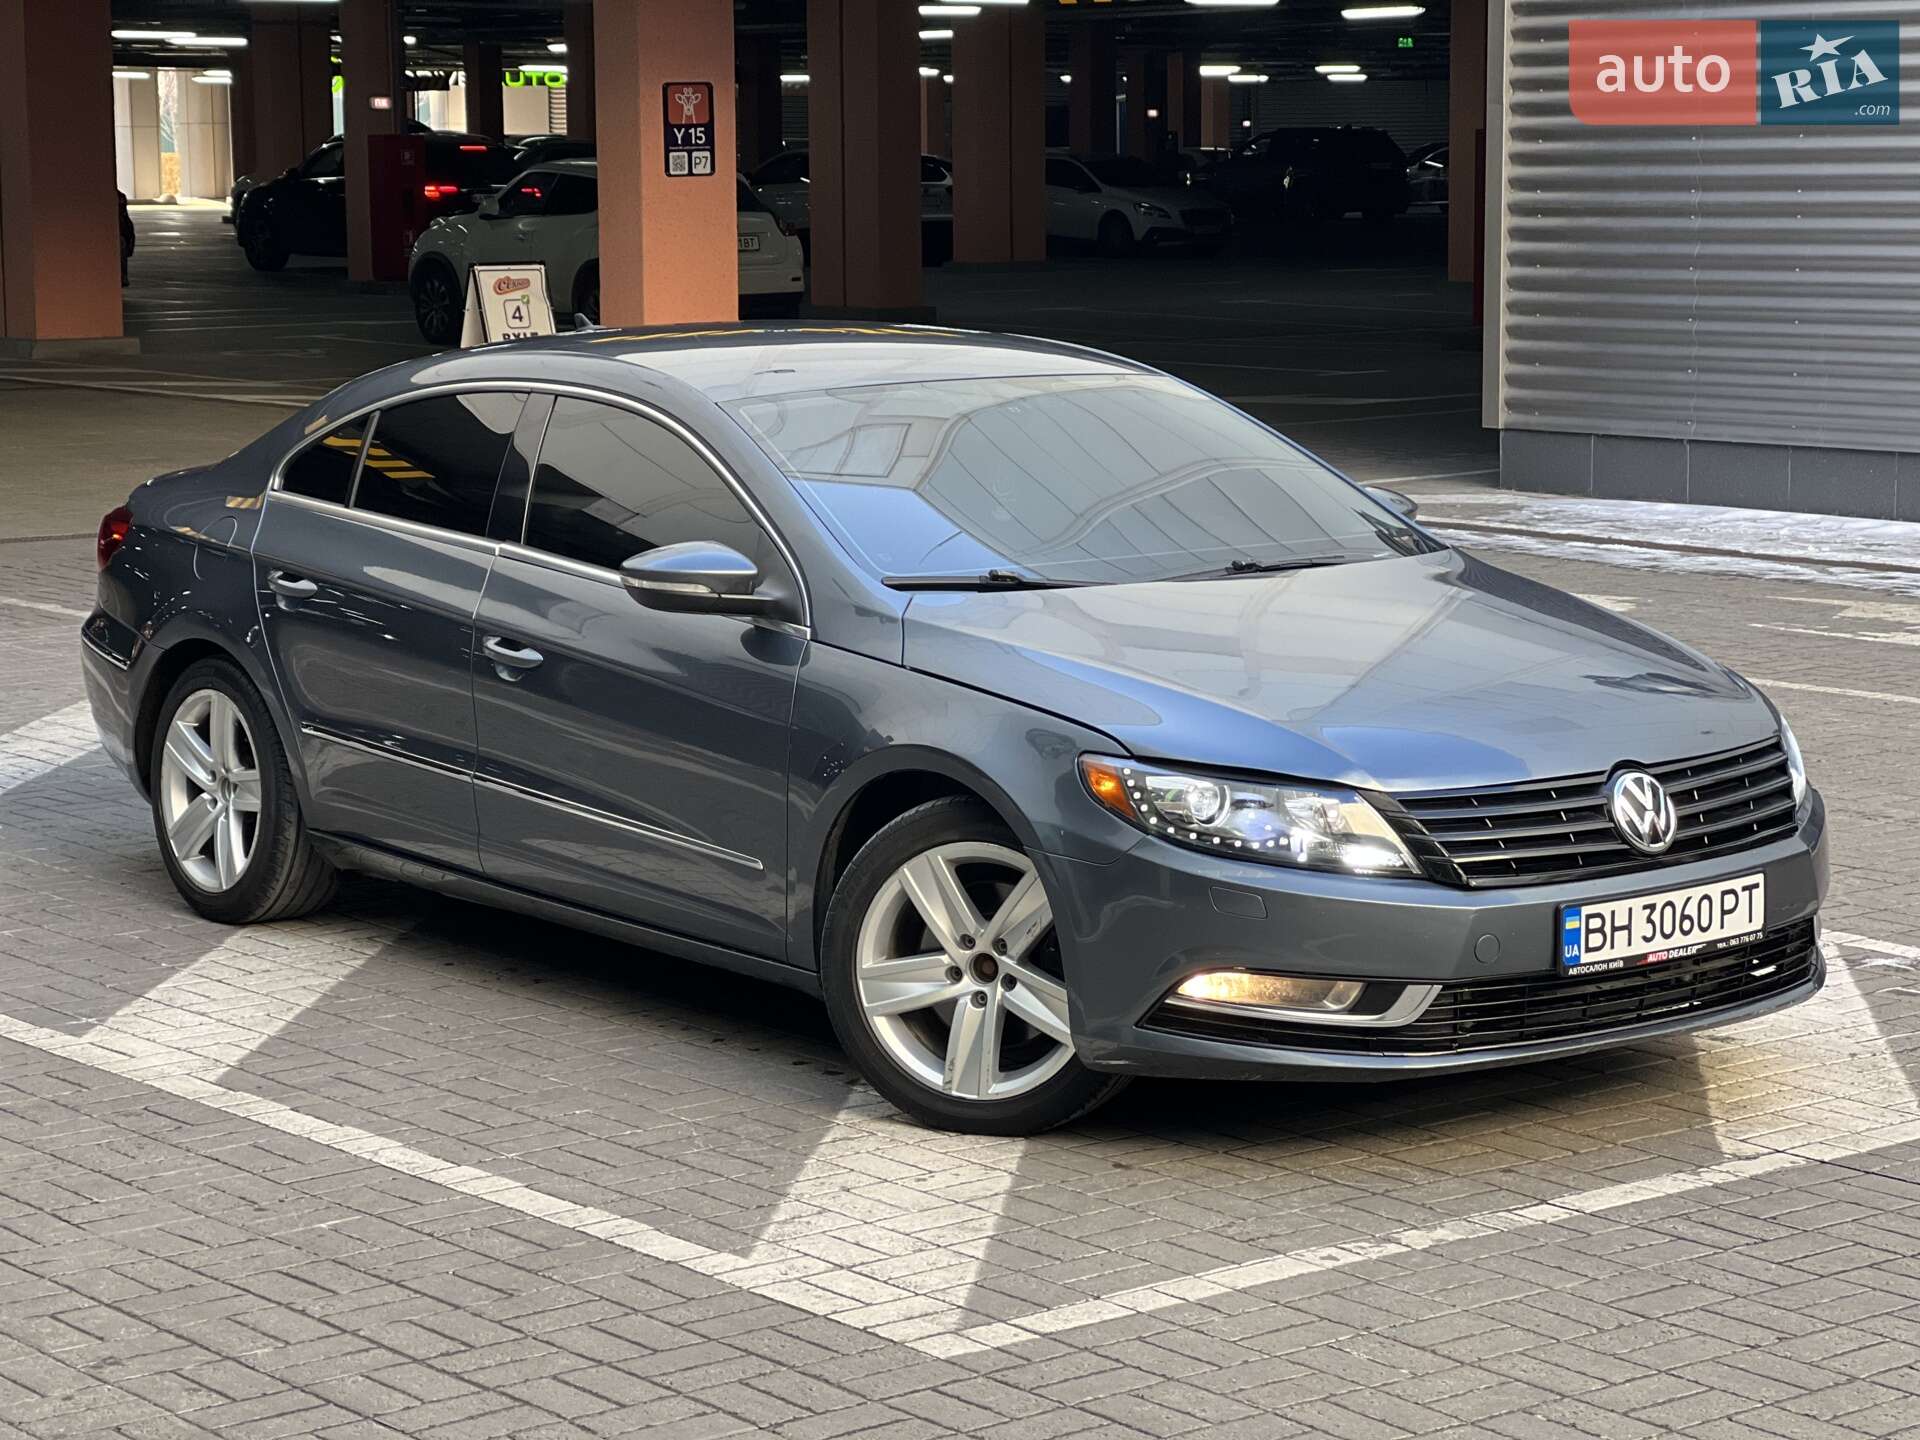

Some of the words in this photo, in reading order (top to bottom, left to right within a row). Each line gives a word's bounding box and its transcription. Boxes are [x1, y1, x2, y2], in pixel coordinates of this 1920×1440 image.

[503, 71, 567, 87] UTO
[673, 127, 685, 144] Y
[688, 127, 706, 144] 15
[693, 155, 708, 169] P7
[512, 305, 523, 322] 4
[1584, 907, 1632, 954] BH
[1641, 893, 1713, 943] 3060
[1720, 882, 1760, 930] PT
[1564, 944, 1579, 958] UA
[1668, 945, 1699, 959] DEALER
